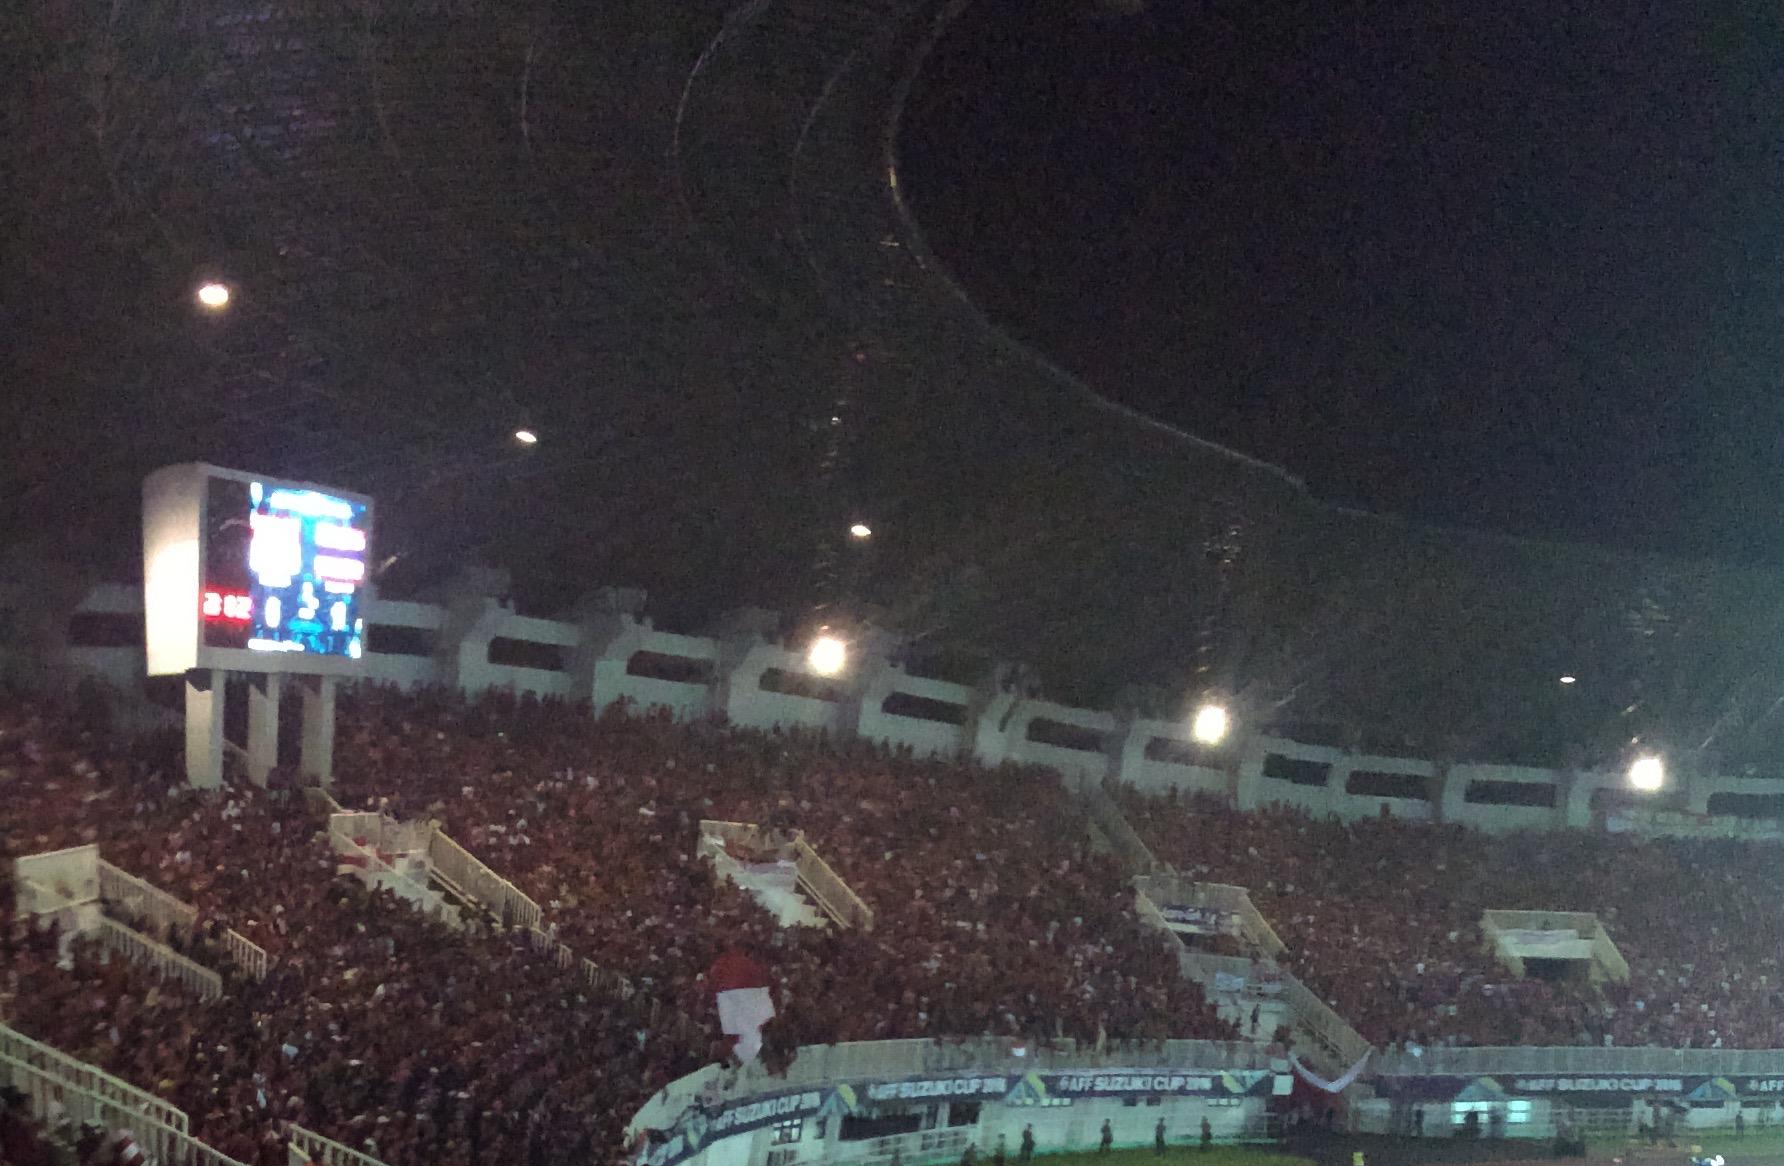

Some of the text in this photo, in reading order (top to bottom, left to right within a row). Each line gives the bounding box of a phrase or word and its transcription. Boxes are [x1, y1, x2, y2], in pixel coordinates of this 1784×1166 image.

[1094, 1076, 1149, 1091] SUZUKI
[1152, 1076, 1184, 1091] CUP
[1621, 1078, 1653, 1091] CUP
